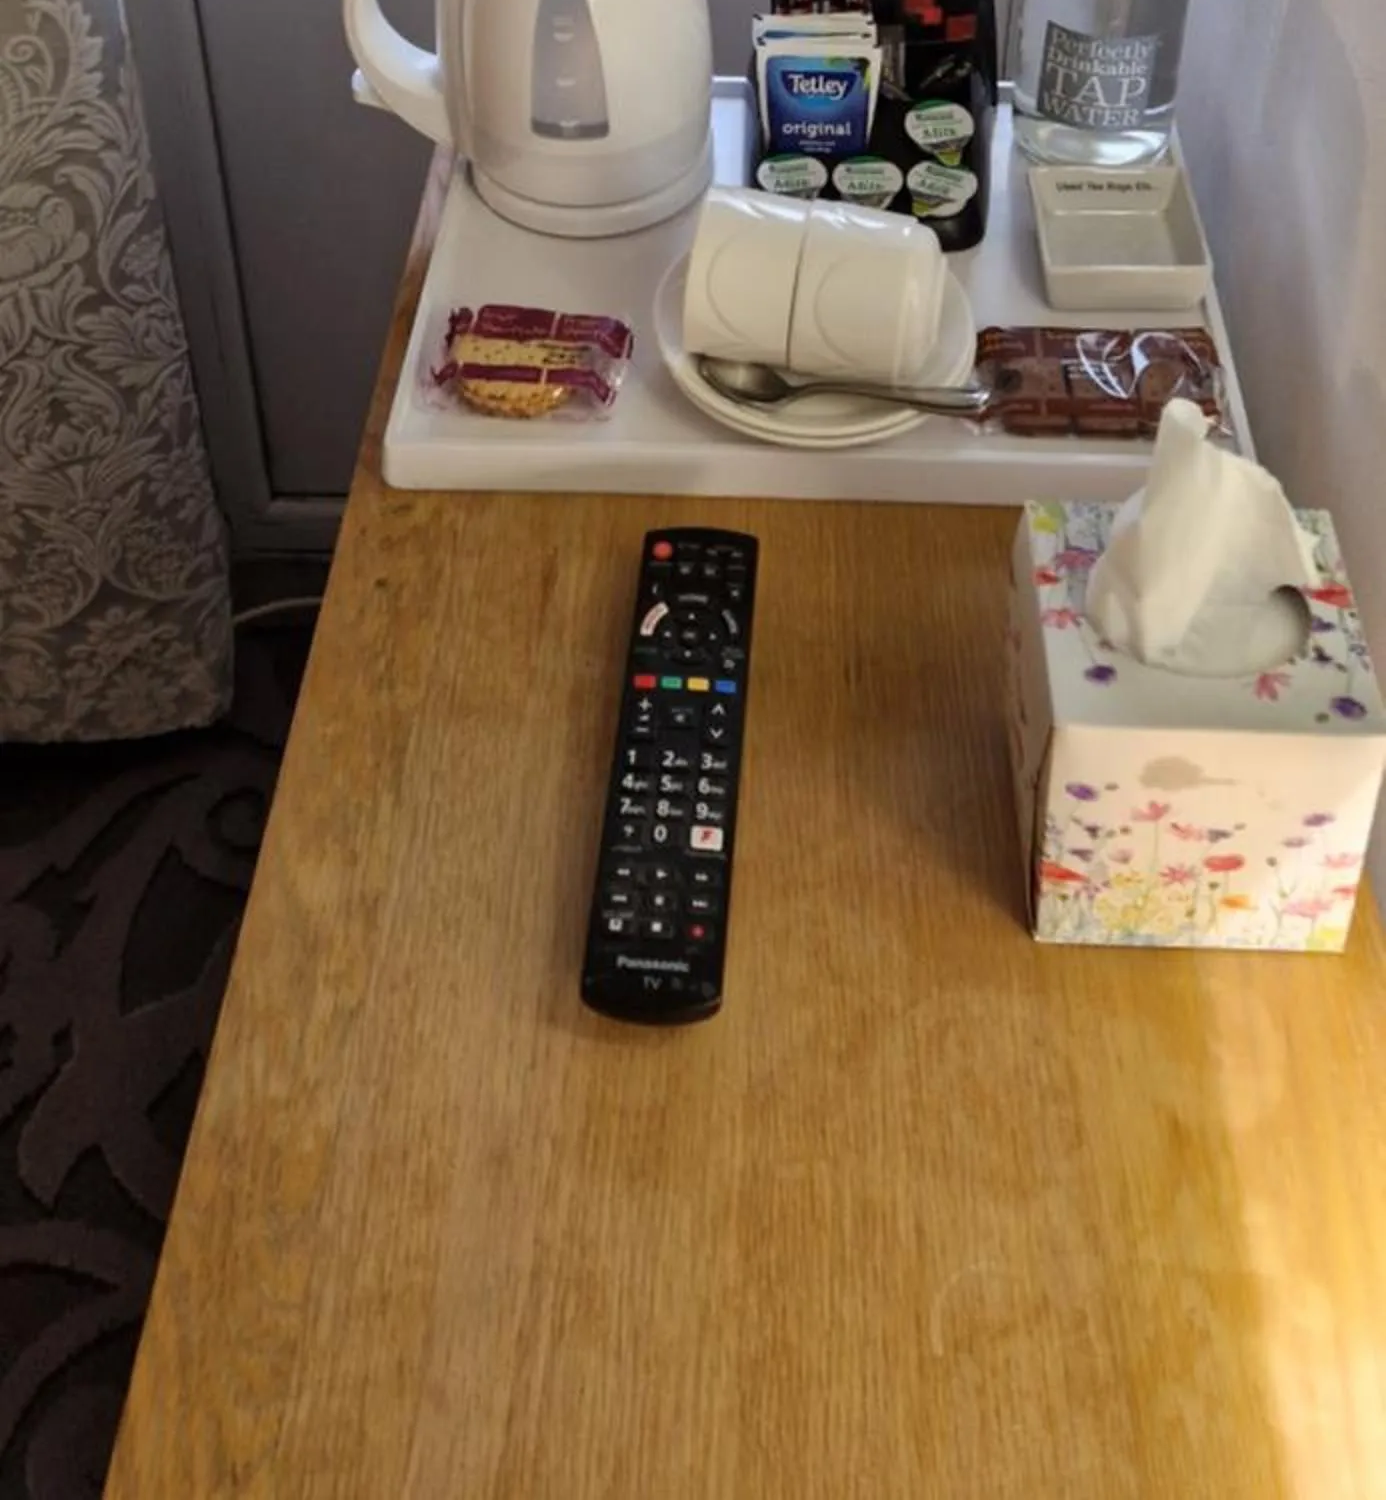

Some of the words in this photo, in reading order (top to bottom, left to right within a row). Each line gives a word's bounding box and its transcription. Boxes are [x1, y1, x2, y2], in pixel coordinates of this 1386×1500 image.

[1052, 29, 1151, 60] Perfectly
[1047, 50, 1147, 76] Drinkable
[787, 74, 848, 100] Tetley
[1047, 63, 1147, 108] TAP
[1044, 92, 1139, 127] WATER
[782, 120, 852, 139] original
[627, 749, 637, 765] 1
[653, 824, 668, 843] 0
